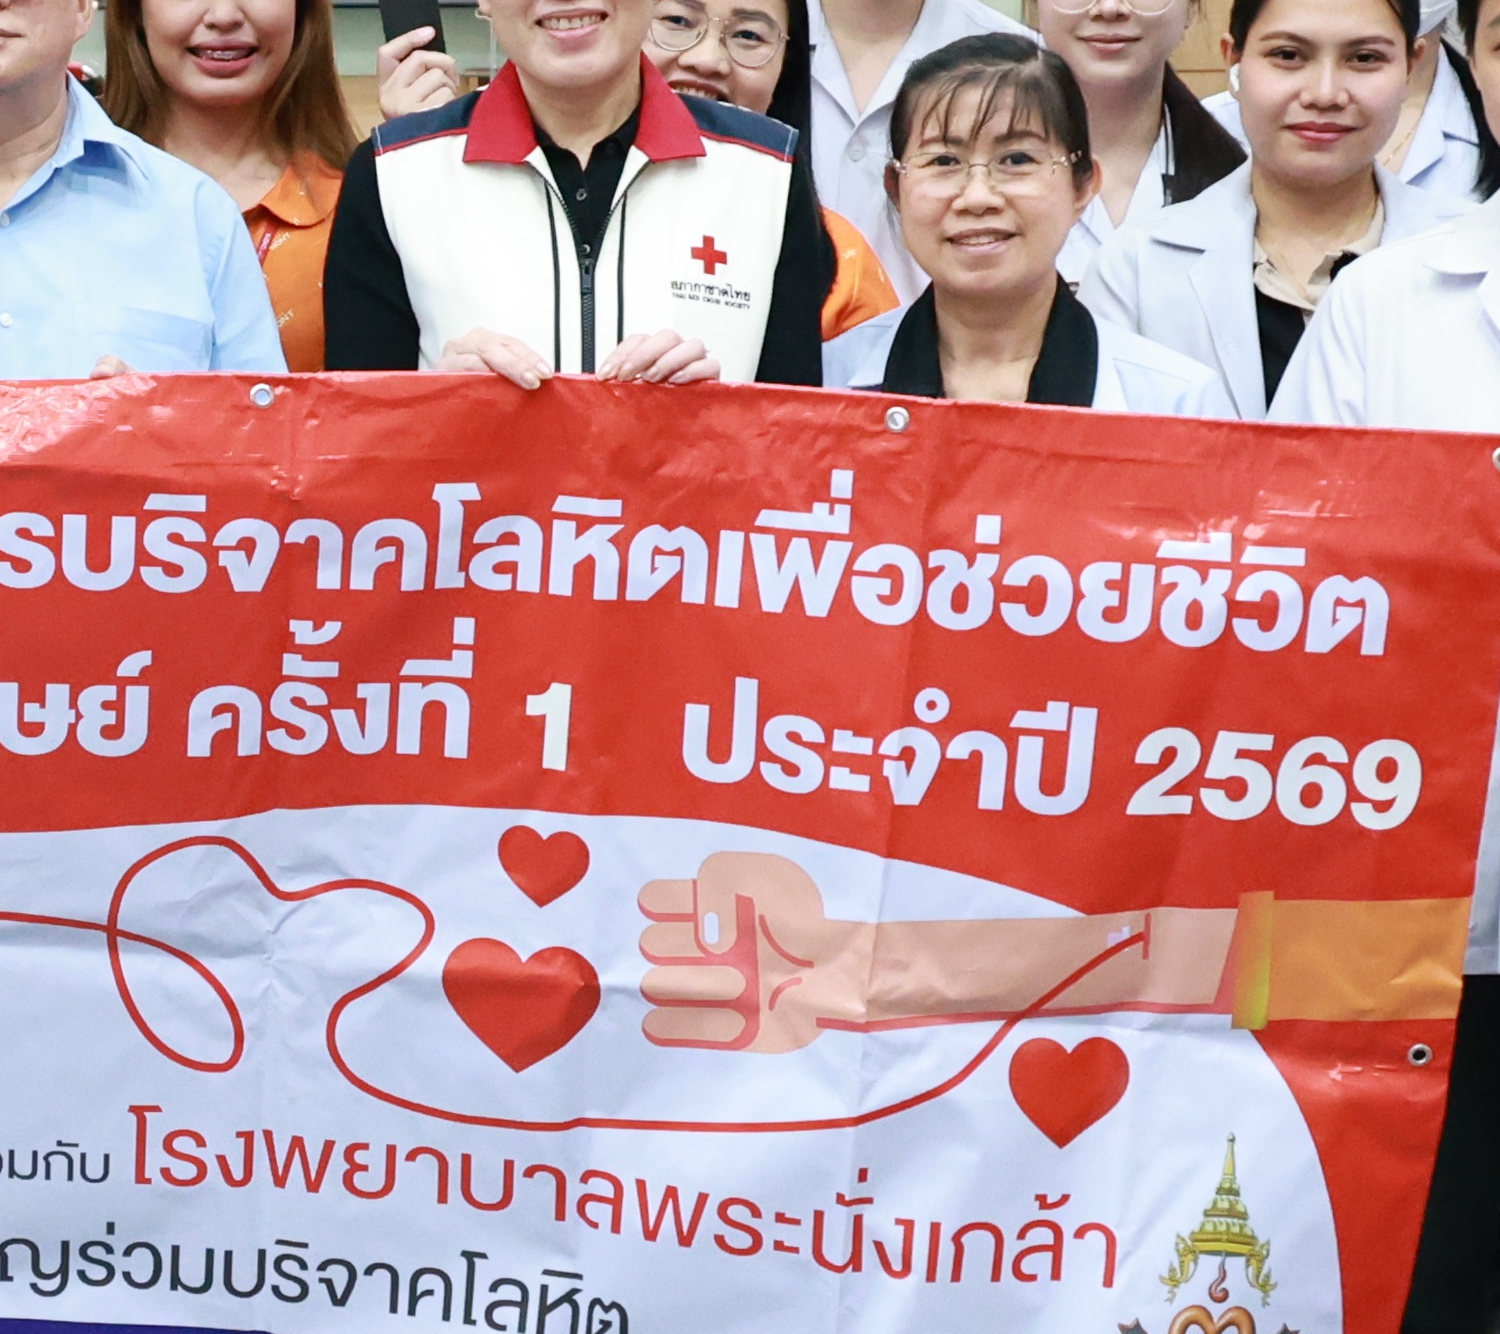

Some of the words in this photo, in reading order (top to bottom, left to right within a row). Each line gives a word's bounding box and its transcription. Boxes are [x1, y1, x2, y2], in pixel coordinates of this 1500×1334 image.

[277, 308, 295, 329] ONT
[187, 617, 475, 759] ครั้งที่
[526, 682, 573, 771] 1
[682, 675, 1098, 817] ประจำปี
[1126, 727, 1423, 831] 2569
[129, 1105, 1116, 1288] โรงพยาบาลพระนั่งเกล้า
